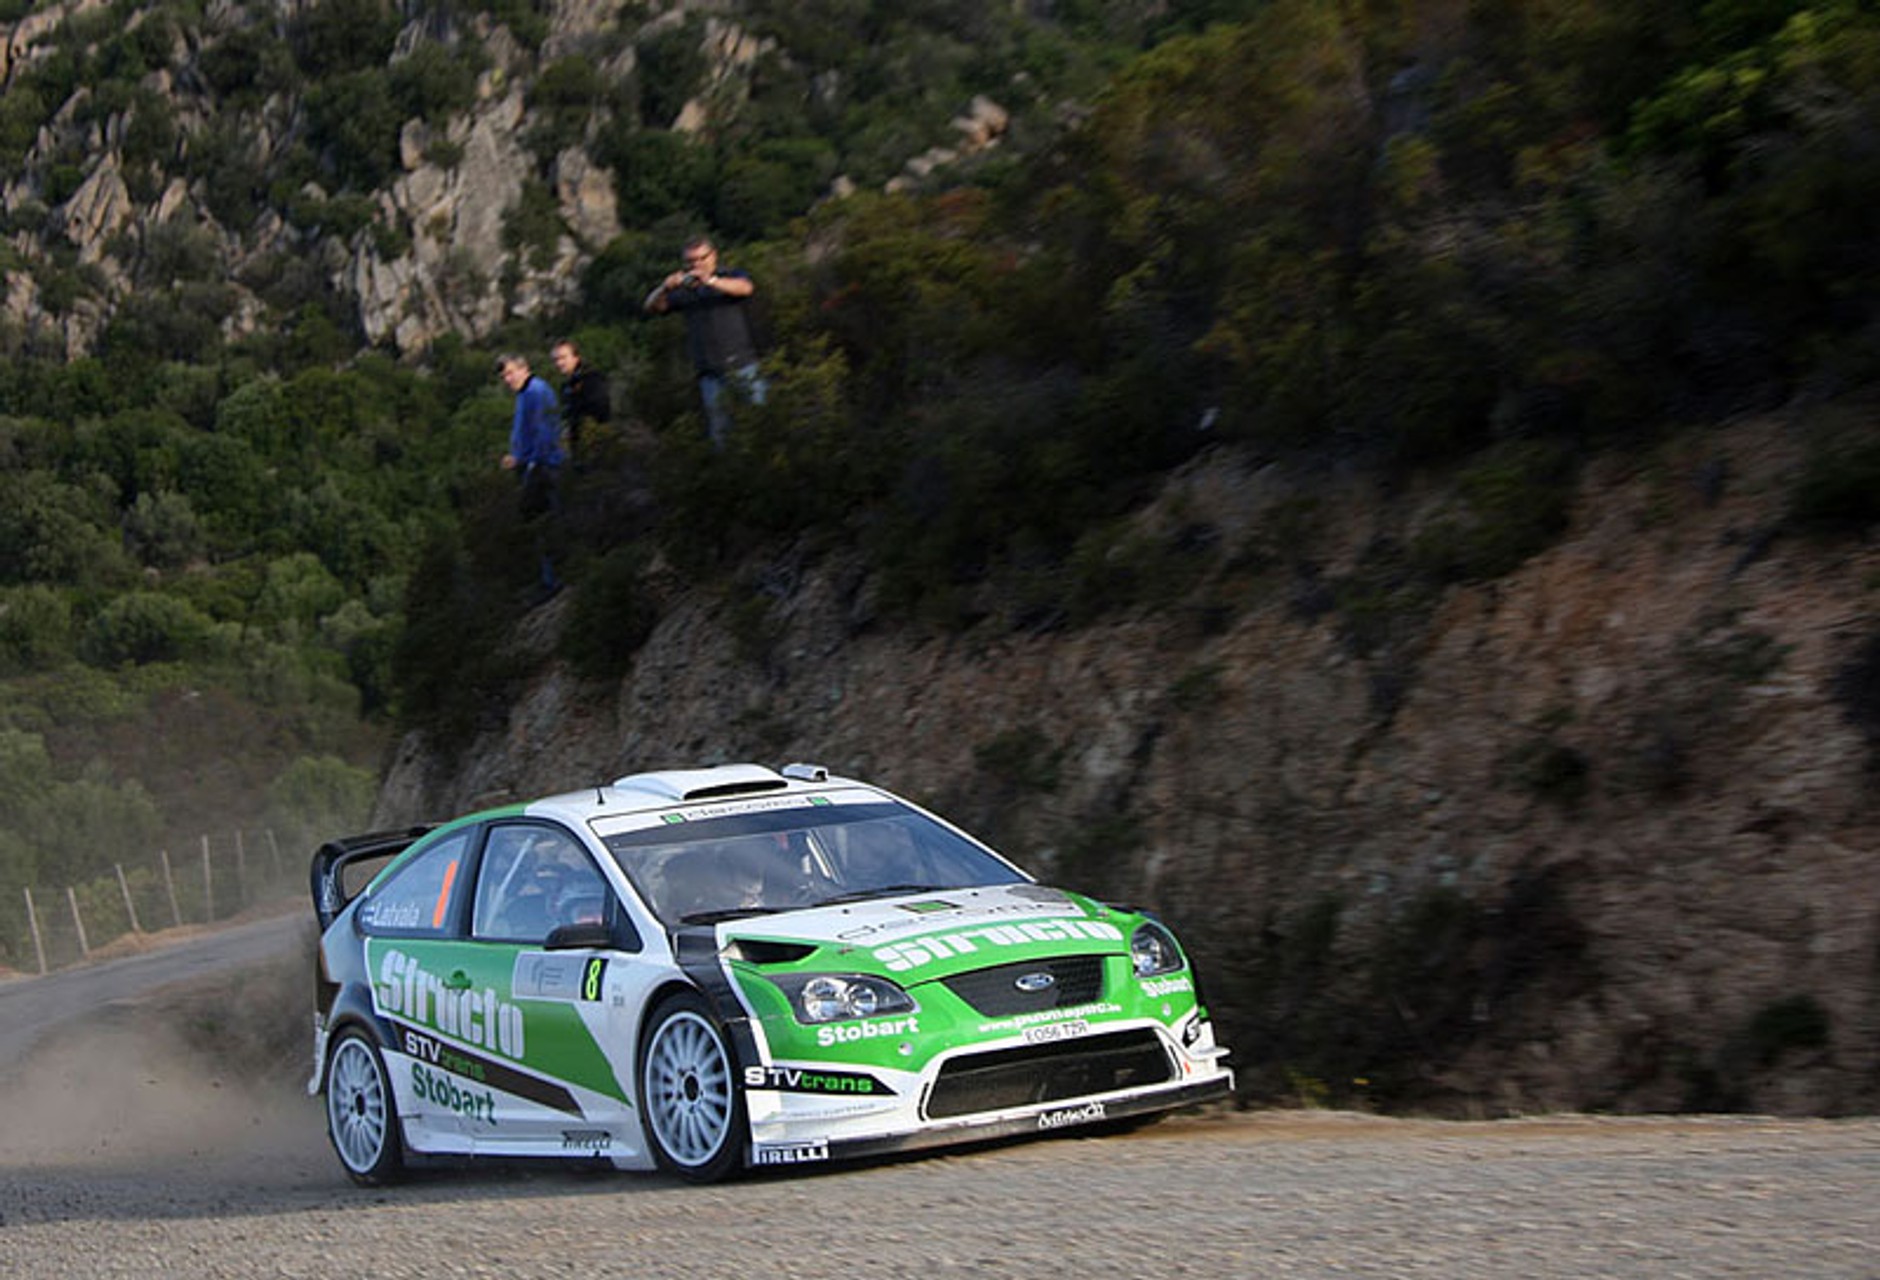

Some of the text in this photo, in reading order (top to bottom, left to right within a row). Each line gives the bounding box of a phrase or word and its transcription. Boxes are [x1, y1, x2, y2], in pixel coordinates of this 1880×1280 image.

[379, 949, 525, 1060] Structo
[586, 959, 601, 1001] 8
[817, 1017, 919, 1046] Stobart
[411, 1062, 497, 1127] Stobart
